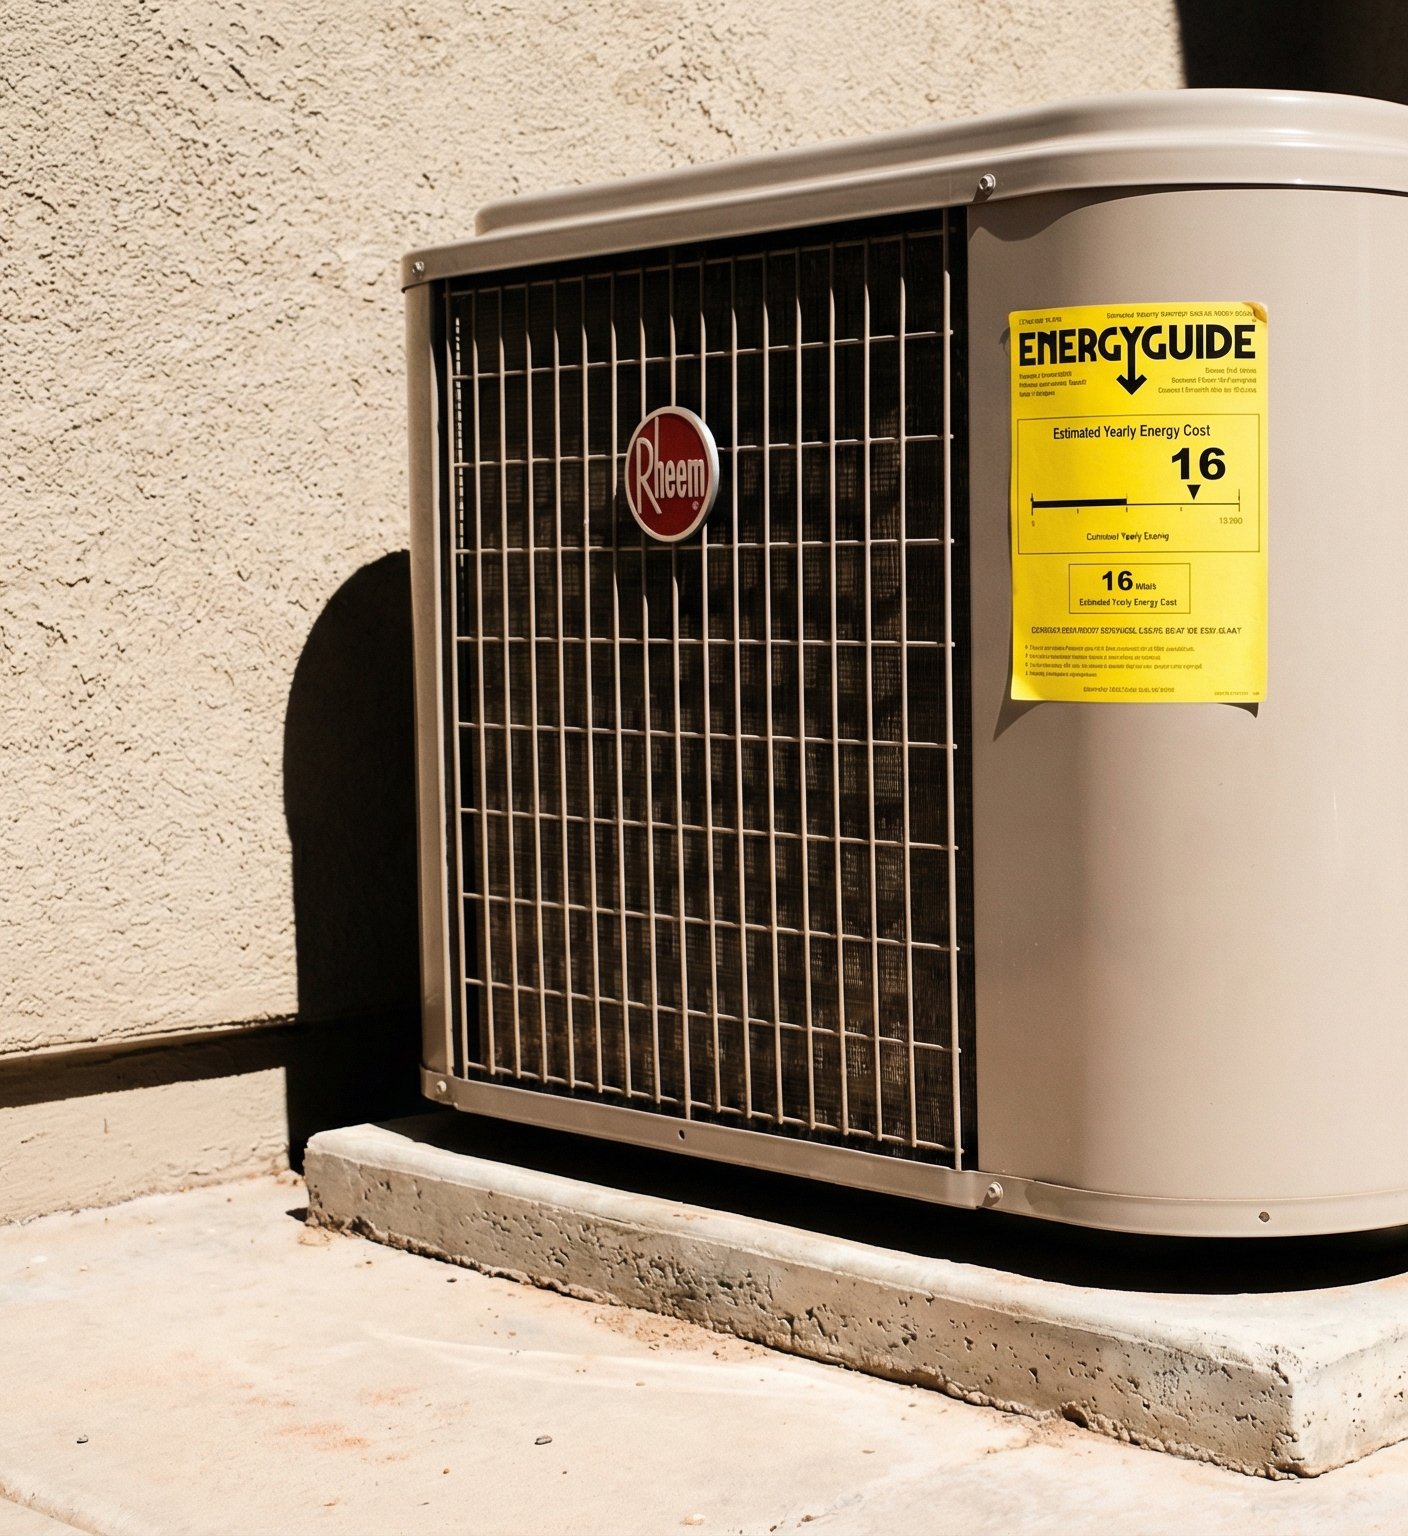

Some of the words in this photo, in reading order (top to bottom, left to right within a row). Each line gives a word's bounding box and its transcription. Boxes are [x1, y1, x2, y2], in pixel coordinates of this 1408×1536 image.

[1019, 325, 1255, 367] ENERGYGUIDE
[1053, 427, 1100, 440] Estimated
[1104, 425, 1136, 440] Yearly
[1140, 424, 1180, 440] Energy
[1184, 423, 1211, 437] Cost
[635, 416, 705, 515] Rheem
[1171, 447, 1226, 481] 16
[1102, 570, 1133, 591] 16
[1133, 598, 1158, 609] Energy
